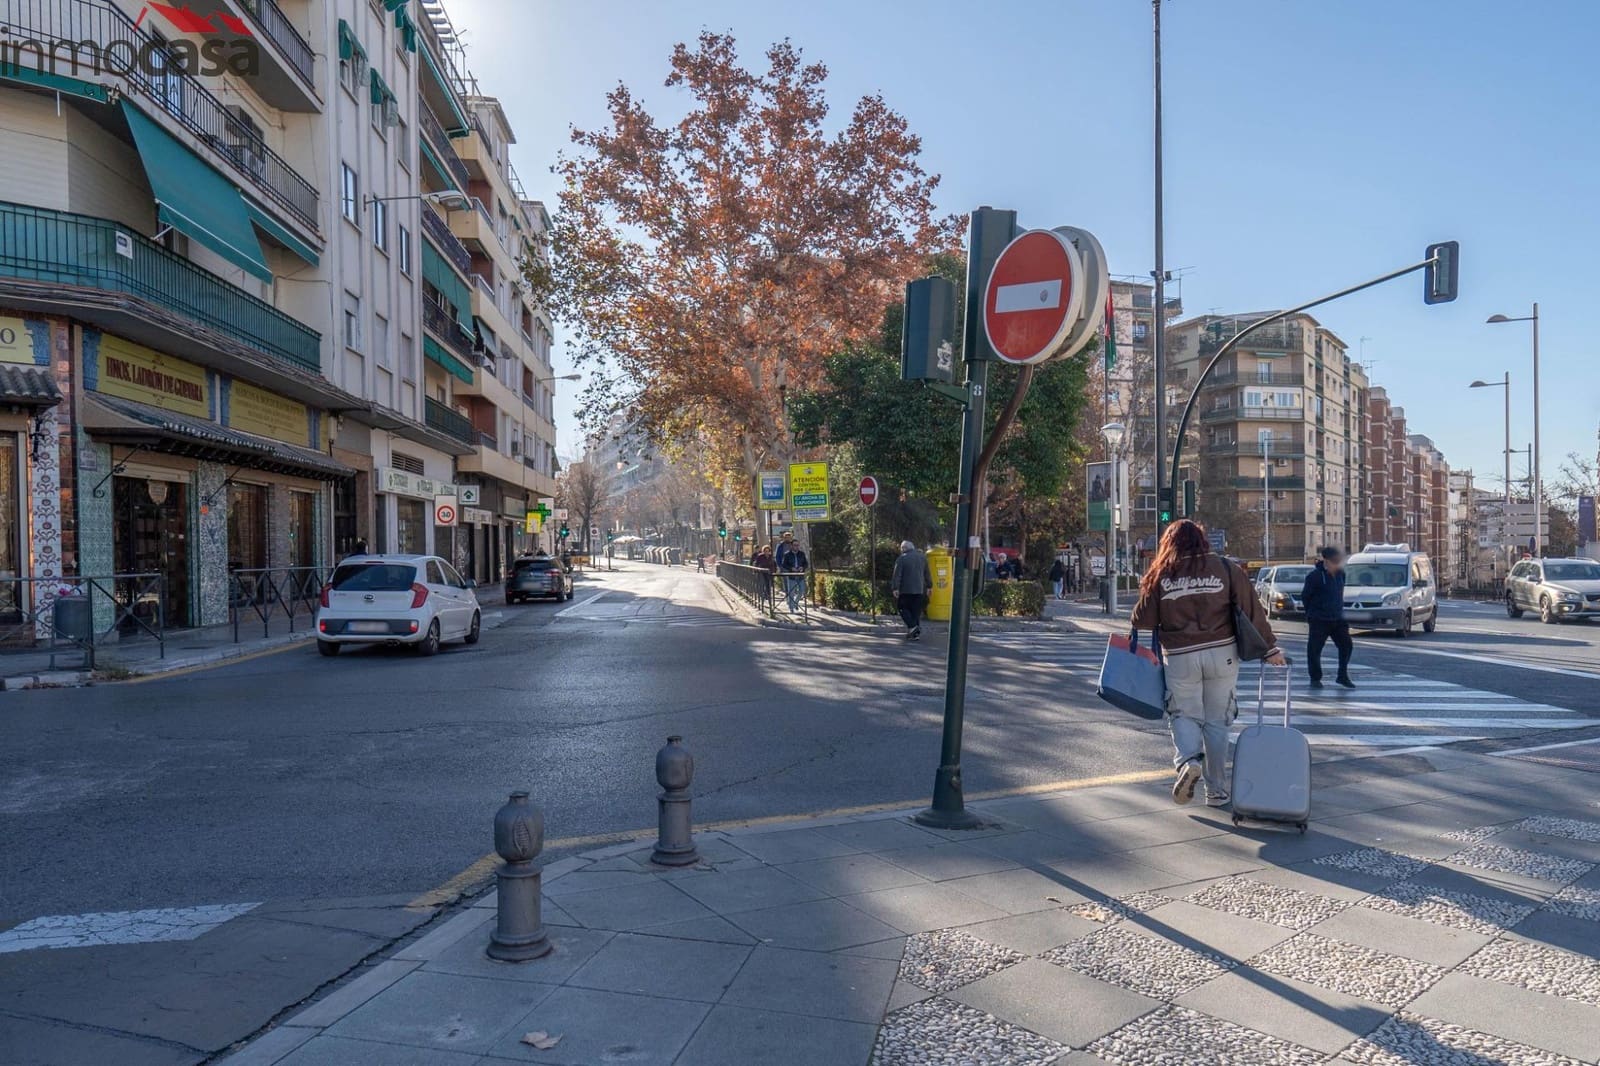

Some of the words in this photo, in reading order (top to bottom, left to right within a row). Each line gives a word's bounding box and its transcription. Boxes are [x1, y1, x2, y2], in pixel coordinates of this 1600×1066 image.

[163, 374, 174, 394] DE
[441, 511, 451, 519] 30
[1161, 575, 1221, 592] California
